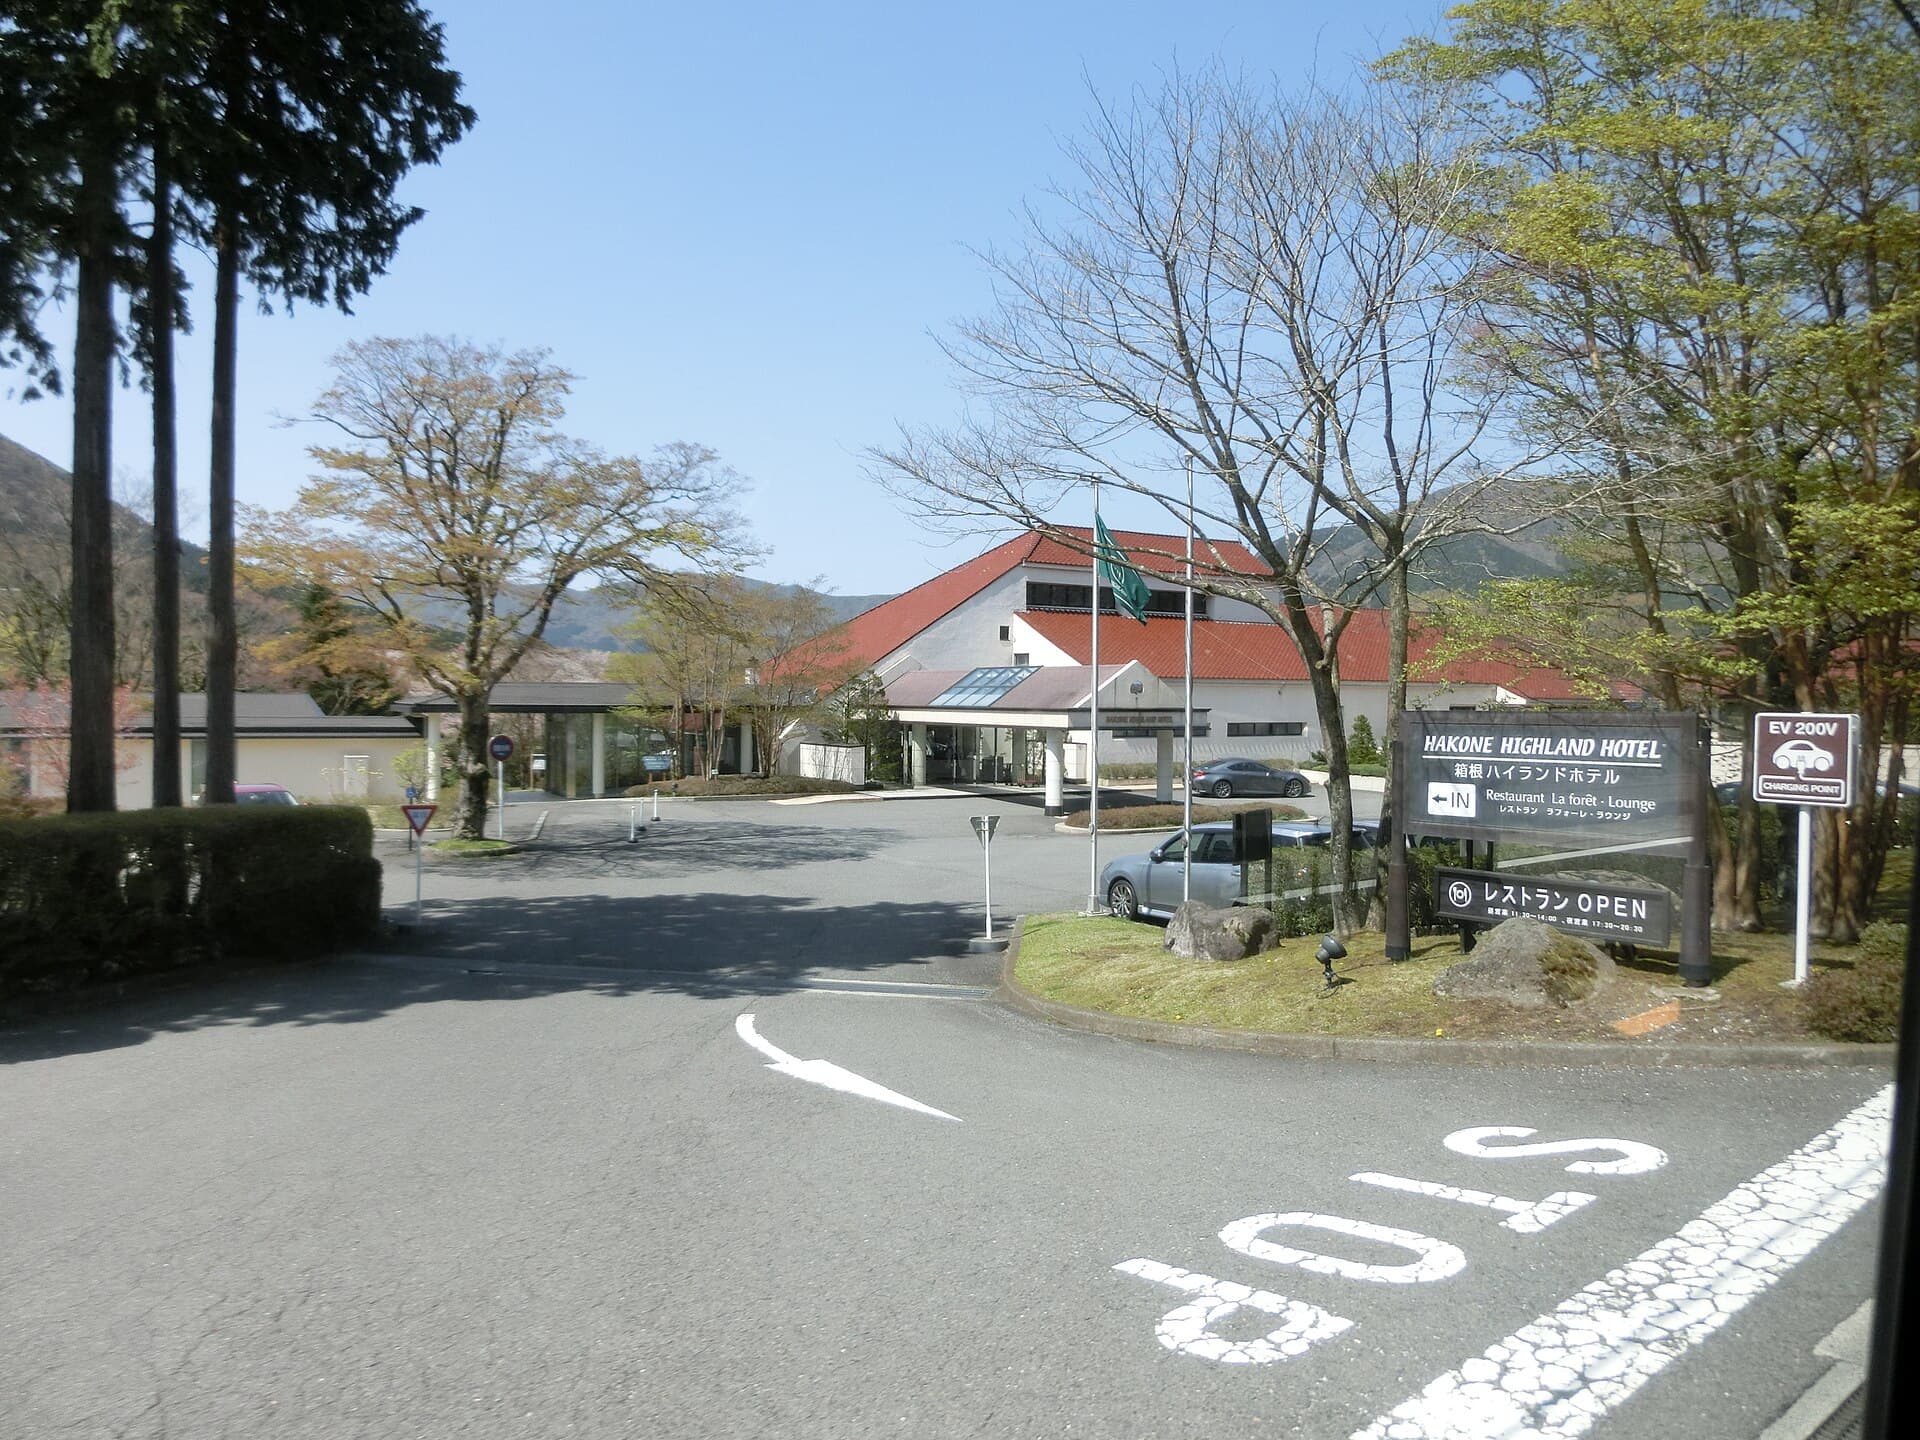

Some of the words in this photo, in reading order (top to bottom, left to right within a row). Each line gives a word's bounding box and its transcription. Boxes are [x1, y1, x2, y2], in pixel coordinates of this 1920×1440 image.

[1769, 721, 1792, 735] EV
[1795, 722, 1838, 736] 200V
[1424, 735, 1493, 753] HAKONE
[1500, 737, 1595, 756] HIGHLAND
[1600, 739, 1662, 758] HOTEL
[1454, 763, 1620, 784] 箱根ハイランドホテル
[1763, 781, 1809, 792] CHARGING
[1811, 784, 1840, 794] POINT
[1451, 792, 1470, 809] IN
[1486, 789, 1545, 804] Restaurant
[1551, 793, 1566, 805] La
[1569, 793, 1598, 807] forêt
[1608, 796, 1657, 813] Lounge
[1499, 805, 1538, 815] レストラン
[1484, 882, 1569, 910] レストラン
[1577, 894, 1647, 919] OPEN
[1112, 1126, 1669, 1364] STOP
